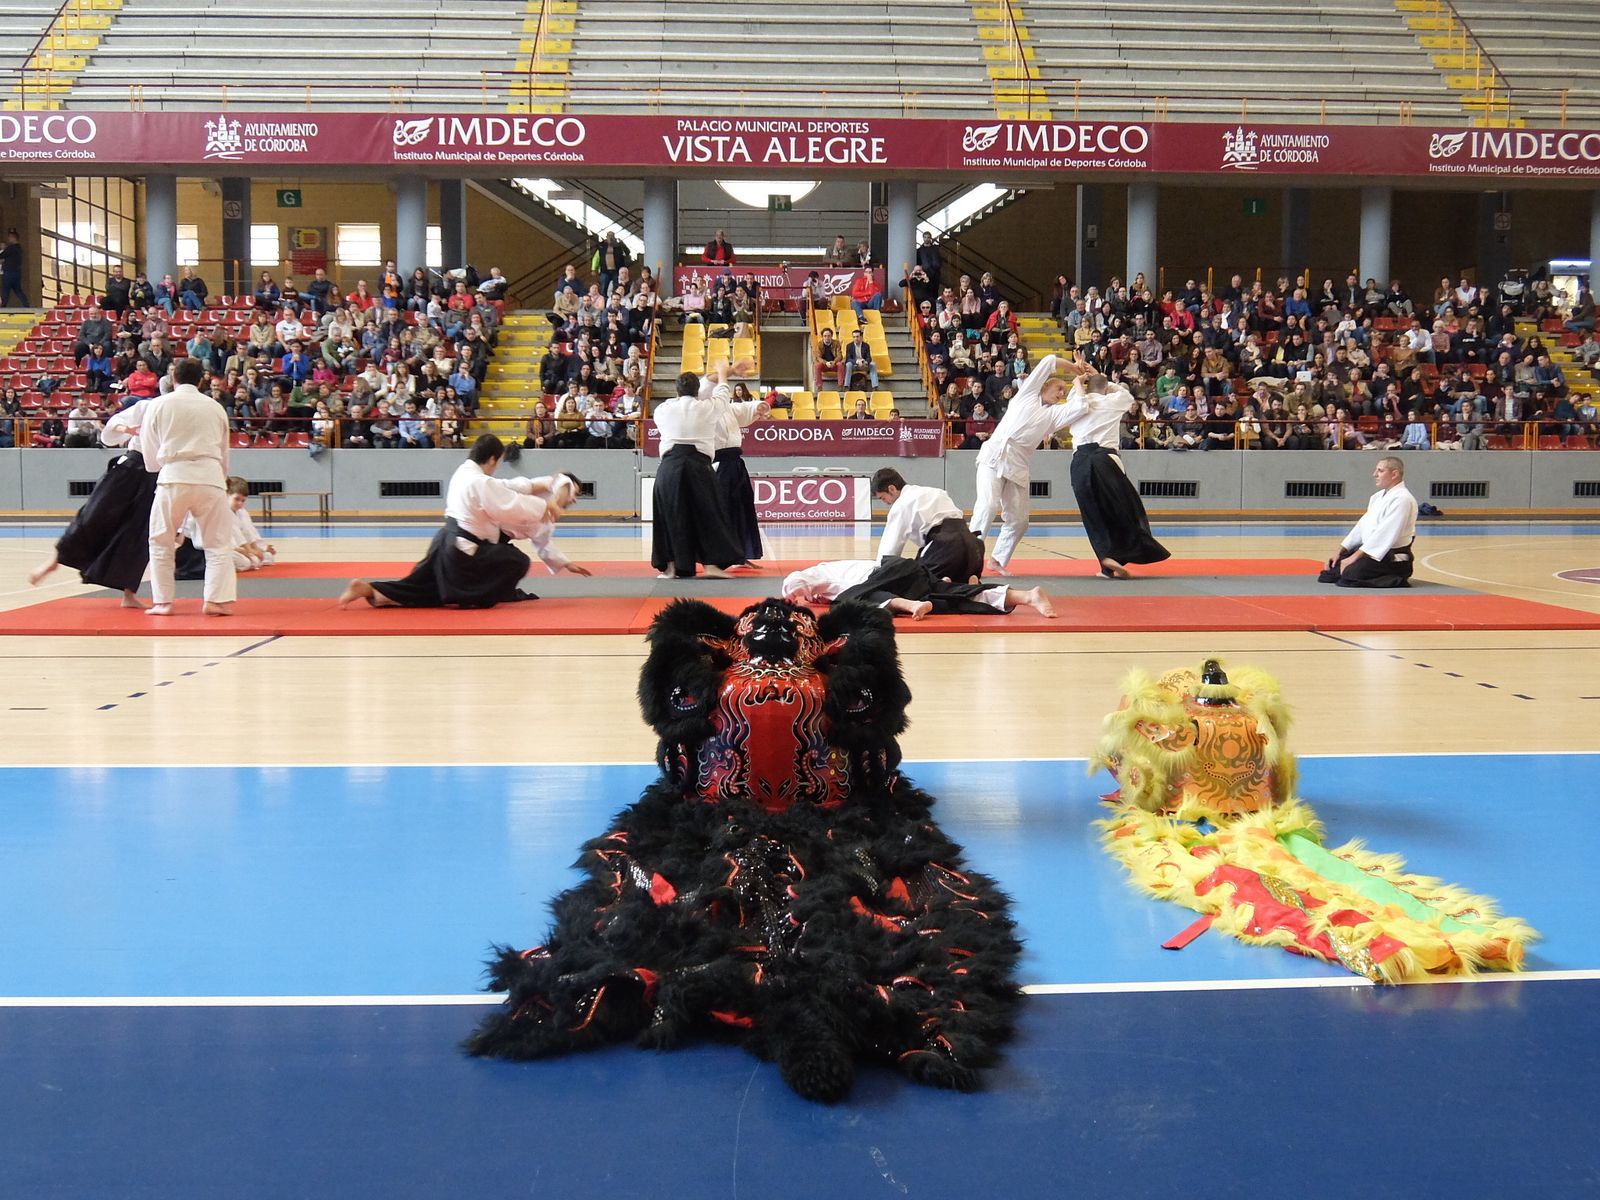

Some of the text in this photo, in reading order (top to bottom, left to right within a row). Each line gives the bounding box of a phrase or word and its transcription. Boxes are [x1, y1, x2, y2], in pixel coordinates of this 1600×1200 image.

[244, 123, 319, 137] AYUNTAMIENTO
[437, 117, 586, 147] IMDECO
[677, 120, 869, 133] PALACIO MUNICIPAL DEPORTES
[244, 137, 308, 152] DE CÓRDOBA
[1006, 124, 1149, 154] IMDECO
[1260, 134, 1330, 148] AYUNTAMIENTO
[1471, 131, 1600, 161] IMDECO
[9, 149, 53, 160] Deportes
[54, 149, 96, 159] Córdoba
[394, 151, 584, 162] Instituto Municipal de Deportes Córdoba
[662, 135, 888, 164] VISTA ALEGRE
[1260, 148, 1319, 163] DE CÓRDOBA
[963, 157, 1147, 169] Instituto Municipal de Deportes Córdoba
[1429, 163, 1466, 173] Instituto
[1467, 164, 1511, 175] Municipal
[1512, 164, 1524, 174] de
[1526, 165, 1567, 176] Deportes
[283, 191, 296, 205] G
[754, 425, 834, 441] CÓRDOBA
[853, 427, 895, 436] IMDECO
[765, 510, 806, 520] Deportes
[807, 509, 846, 518] Córdoba
